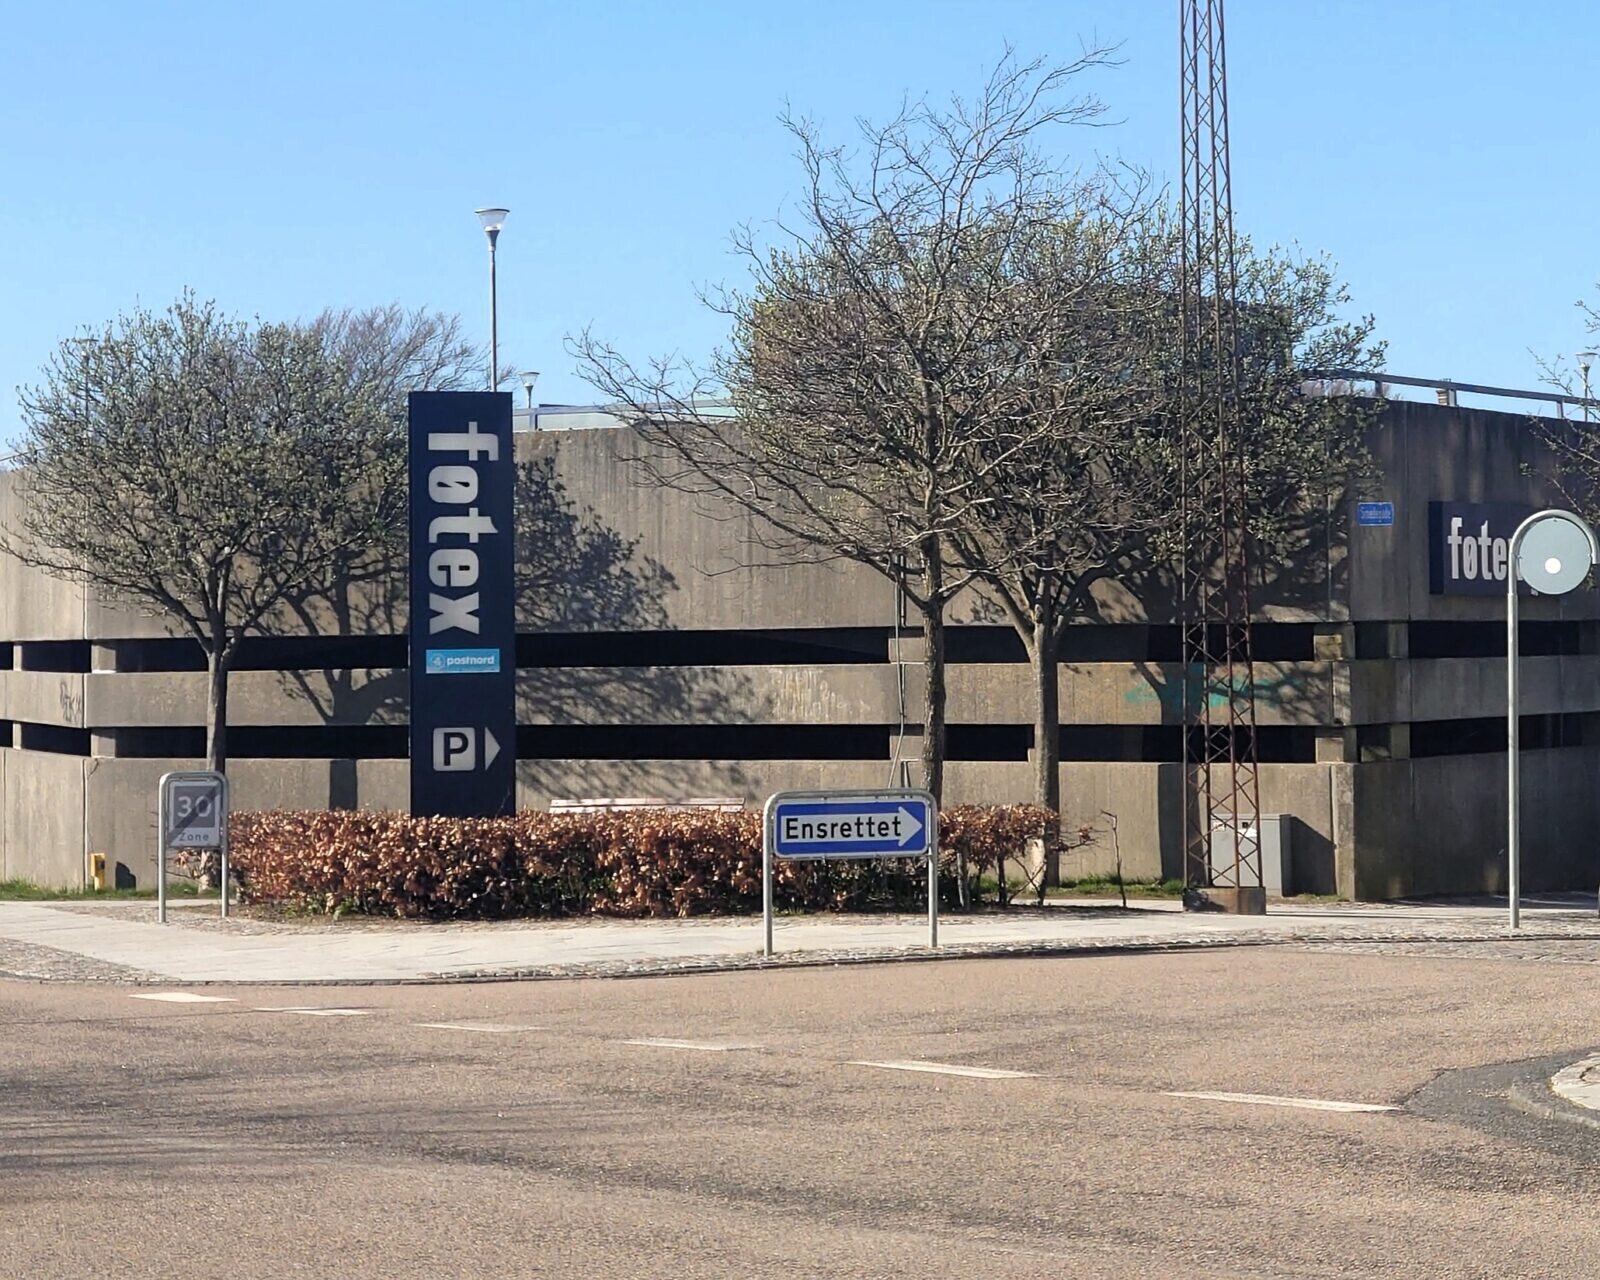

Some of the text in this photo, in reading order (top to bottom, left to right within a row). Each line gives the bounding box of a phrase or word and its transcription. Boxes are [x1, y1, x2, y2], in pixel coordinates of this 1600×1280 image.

[428, 421, 499, 635] føtex
[1447, 517, 1524, 580] føte
[447, 655, 495, 666] postnord
[443, 732, 469, 766] P
[177, 795, 212, 818] 30
[179, 832, 210, 842] Zone
[786, 816, 902, 840] Ensrettet
